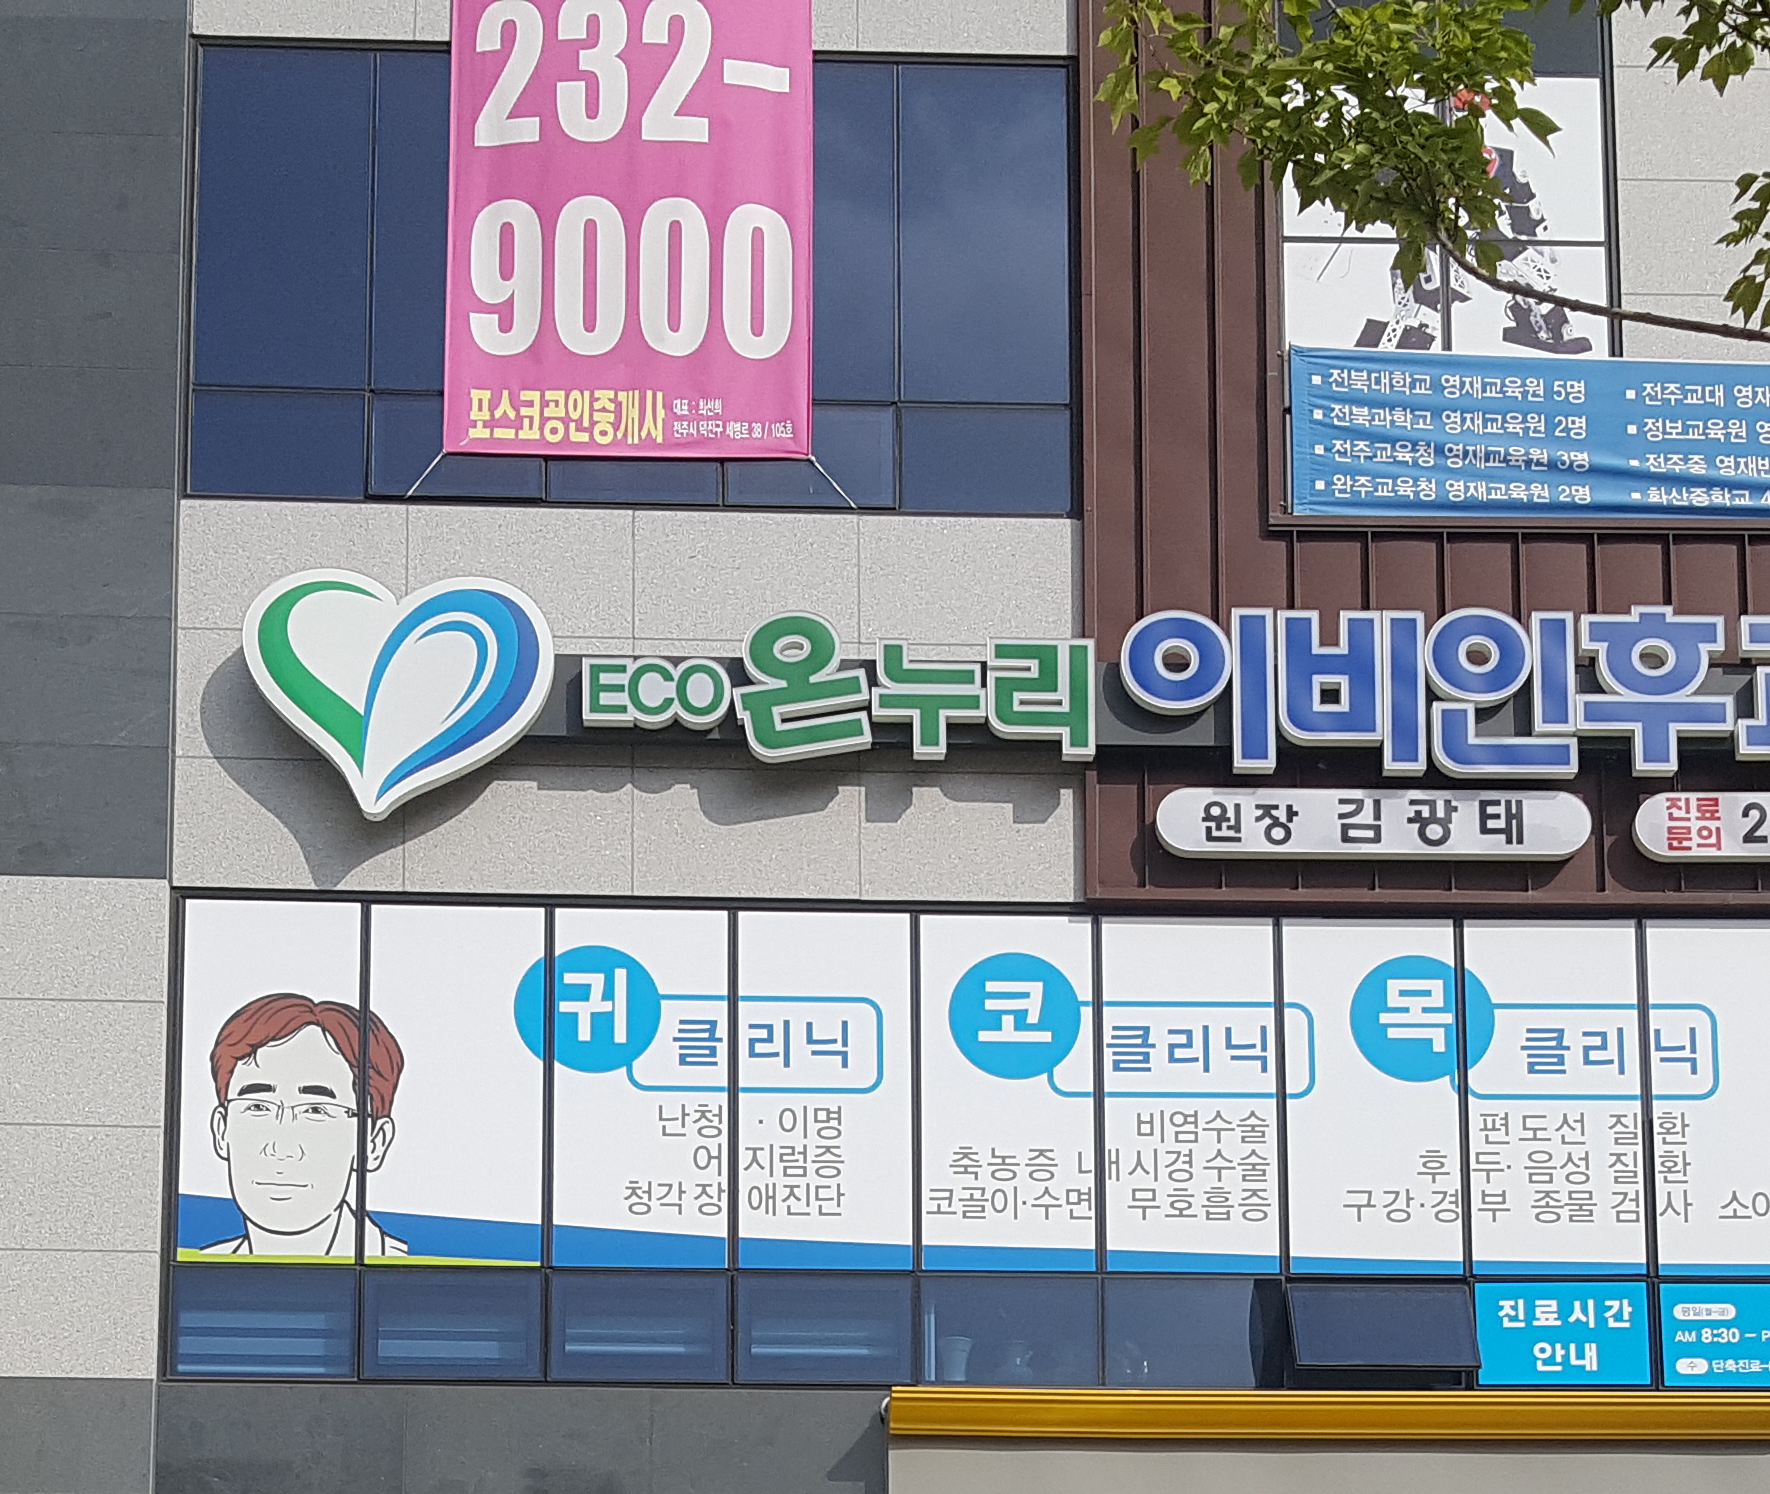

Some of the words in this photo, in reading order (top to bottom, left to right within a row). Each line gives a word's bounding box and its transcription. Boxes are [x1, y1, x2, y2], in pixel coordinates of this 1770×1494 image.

[474, 0, 790, 146] 232-
[470, 195, 793, 360] 9000
[1329, 368, 1433, 397] 전북대학교
[1440, 372, 1545, 402] 영재교육원
[1552, 378, 1586, 403] 5명
[1641, 382, 1724, 407] 전주교대
[469, 389, 665, 444] 포스코공인중개사
[1330, 404, 1434, 432] 전북과학고
[1441, 409, 1546, 437] 영재교육원
[1553, 413, 1587, 438] 2명
[1642, 419, 1747, 443] 정보교육원
[1331, 441, 1435, 467] 전주교육청
[1443, 444, 1548, 471] 영재교육원
[1557, 448, 1590, 473] 3명
[1645, 454, 1707, 476] 전주중
[1331, 476, 1437, 502] 완주교육청
[1444, 480, 1549, 504] 영재교육원
[1558, 484, 1591, 506] 2명
[1201, 800, 1300, 845] 원장
[1336, 797, 1526, 848] 김광태
[1665, 797, 1722, 825] 진료
[1665, 825, 1723, 852] 문의
[558, 967, 627, 1044] 귀
[672, 1019, 849, 1068] 클리닉
[977, 980, 1053, 1042] 코
[1106, 1024, 1268, 1073] 클리닉
[1378, 978, 1453, 1053] 목
[1520, 1027, 1698, 1075] 클리닉
[1136, 1109, 1270, 1144] 비염수술
[1478, 1112, 1587, 1146] 편도선
[1607, 1112, 1691, 1146] 질환
[692, 1142, 845, 1179] 어지럼증
[948, 1147, 1059, 1182] 축농증
[1607, 1150, 1692, 1185] 질환
[1127, 1187, 1272, 1222] 무호흡증
[1498, 1298, 1633, 1328] 진료시간
[1674, 1331, 1696, 1342] AM
[1701, 1328, 1740, 1343] 8:30
[1533, 1342, 1598, 1371] 안내
